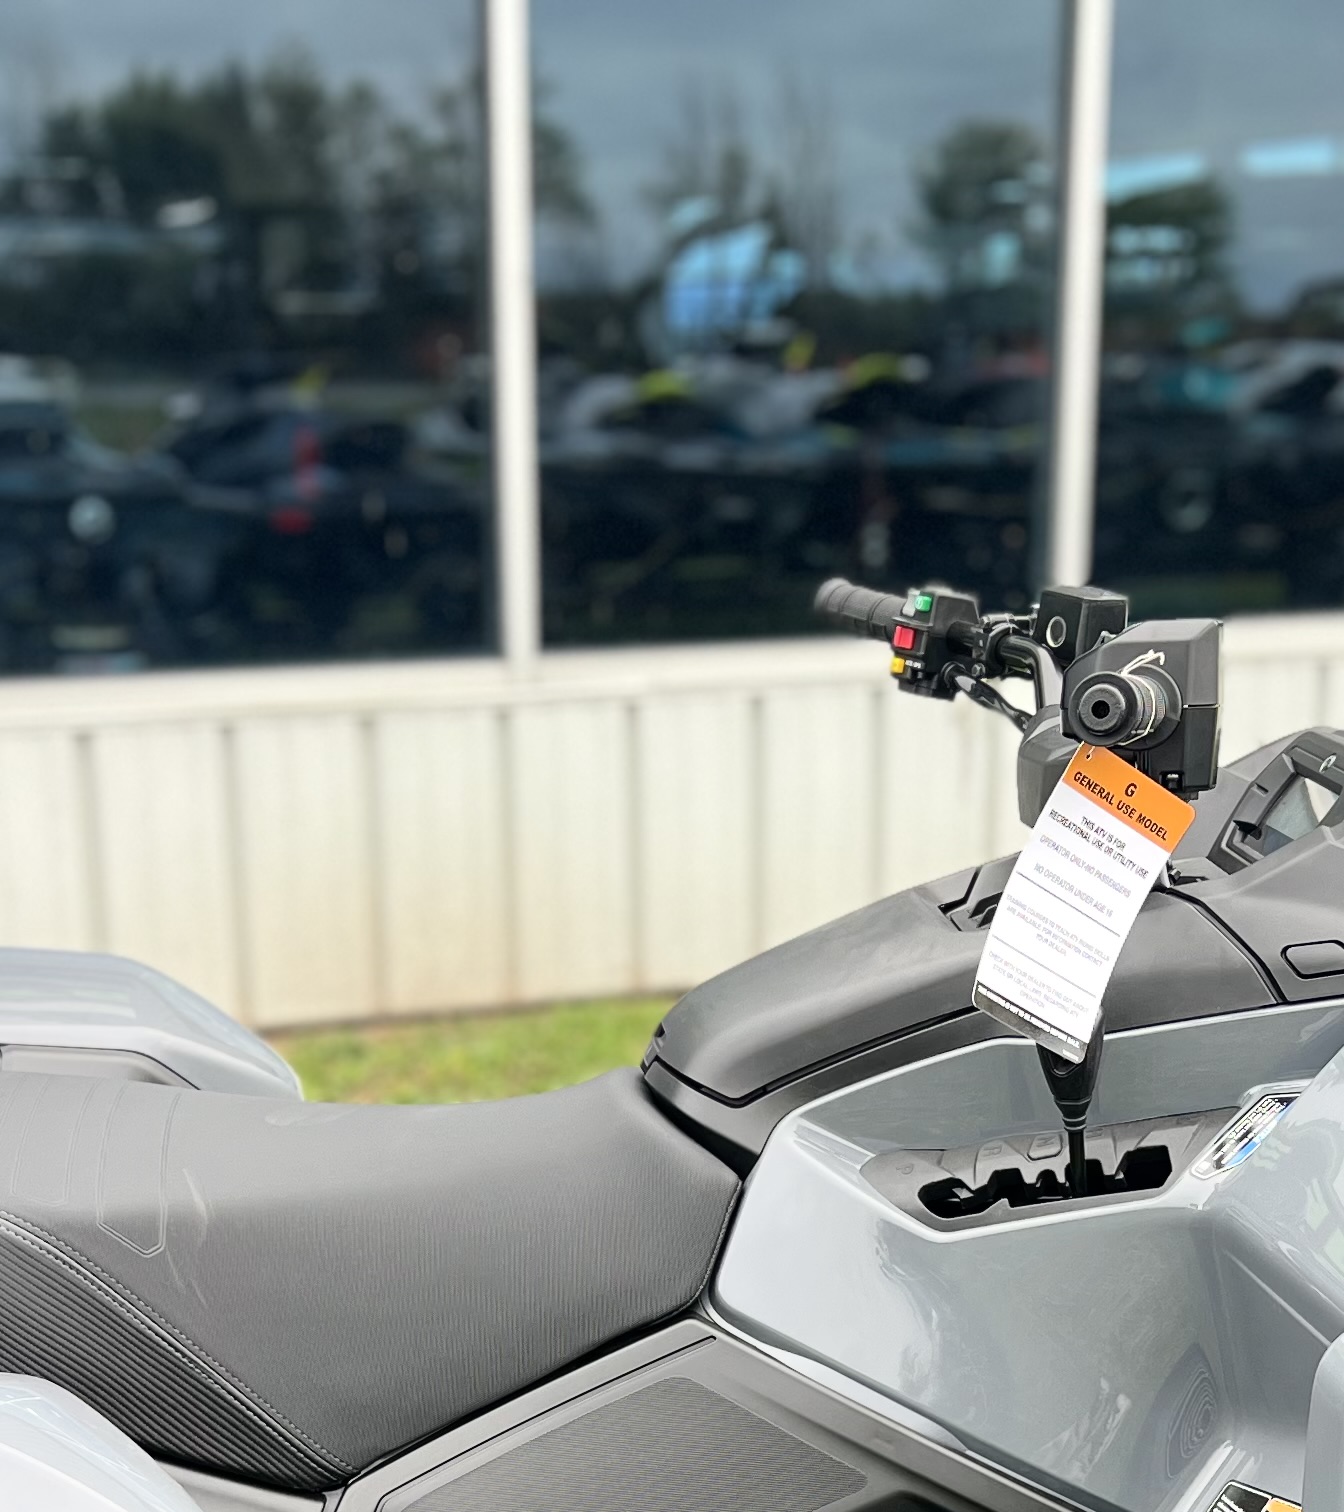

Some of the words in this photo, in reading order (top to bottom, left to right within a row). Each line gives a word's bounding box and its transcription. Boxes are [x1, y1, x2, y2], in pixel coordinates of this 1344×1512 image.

[1073, 771, 1115, 806] GENERAL
[1116, 800, 1137, 820] USE
[1135, 813, 1168, 841] MODEL
[1124, 782, 1138, 798] G
[1048, 809, 1091, 843] RECREATIONAL
[1091, 837, 1105, 851] USE
[1103, 845, 1114, 857] OR
[1112, 850, 1137, 871] UTILITY
[1135, 866, 1149, 880] USE
[1080, 815, 1096, 831] THIS
[1093, 826, 1108, 839] ATV
[1105, 832, 1115, 843] IS
[1113, 837, 1126, 851] FOR
